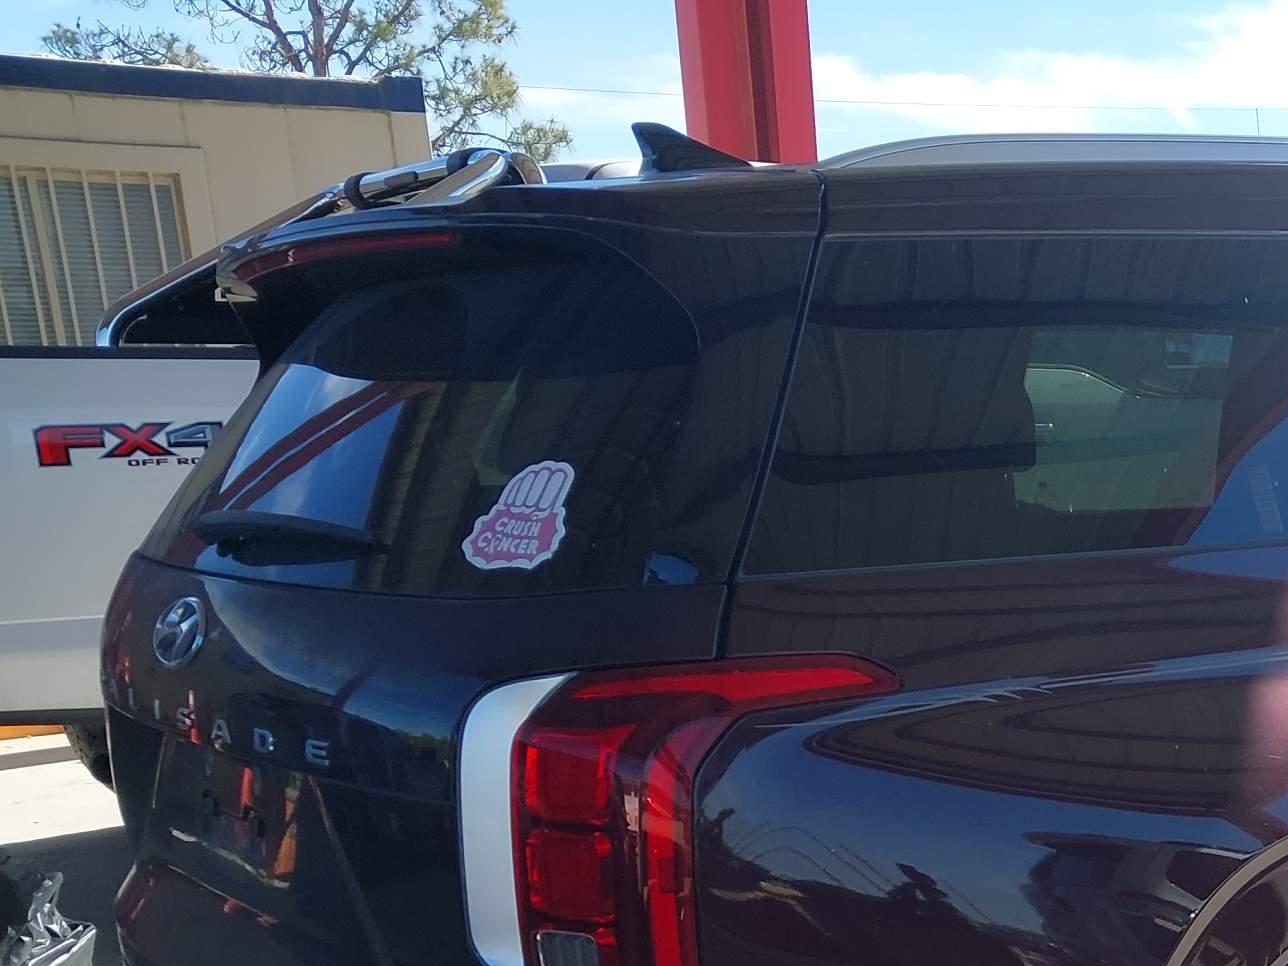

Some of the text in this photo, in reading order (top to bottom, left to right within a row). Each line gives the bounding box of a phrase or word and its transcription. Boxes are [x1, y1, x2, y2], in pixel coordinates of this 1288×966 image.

[34, 422, 222, 466] FX4
[128, 458, 168, 467] OFF
[495, 517, 541, 537] CRUSH
